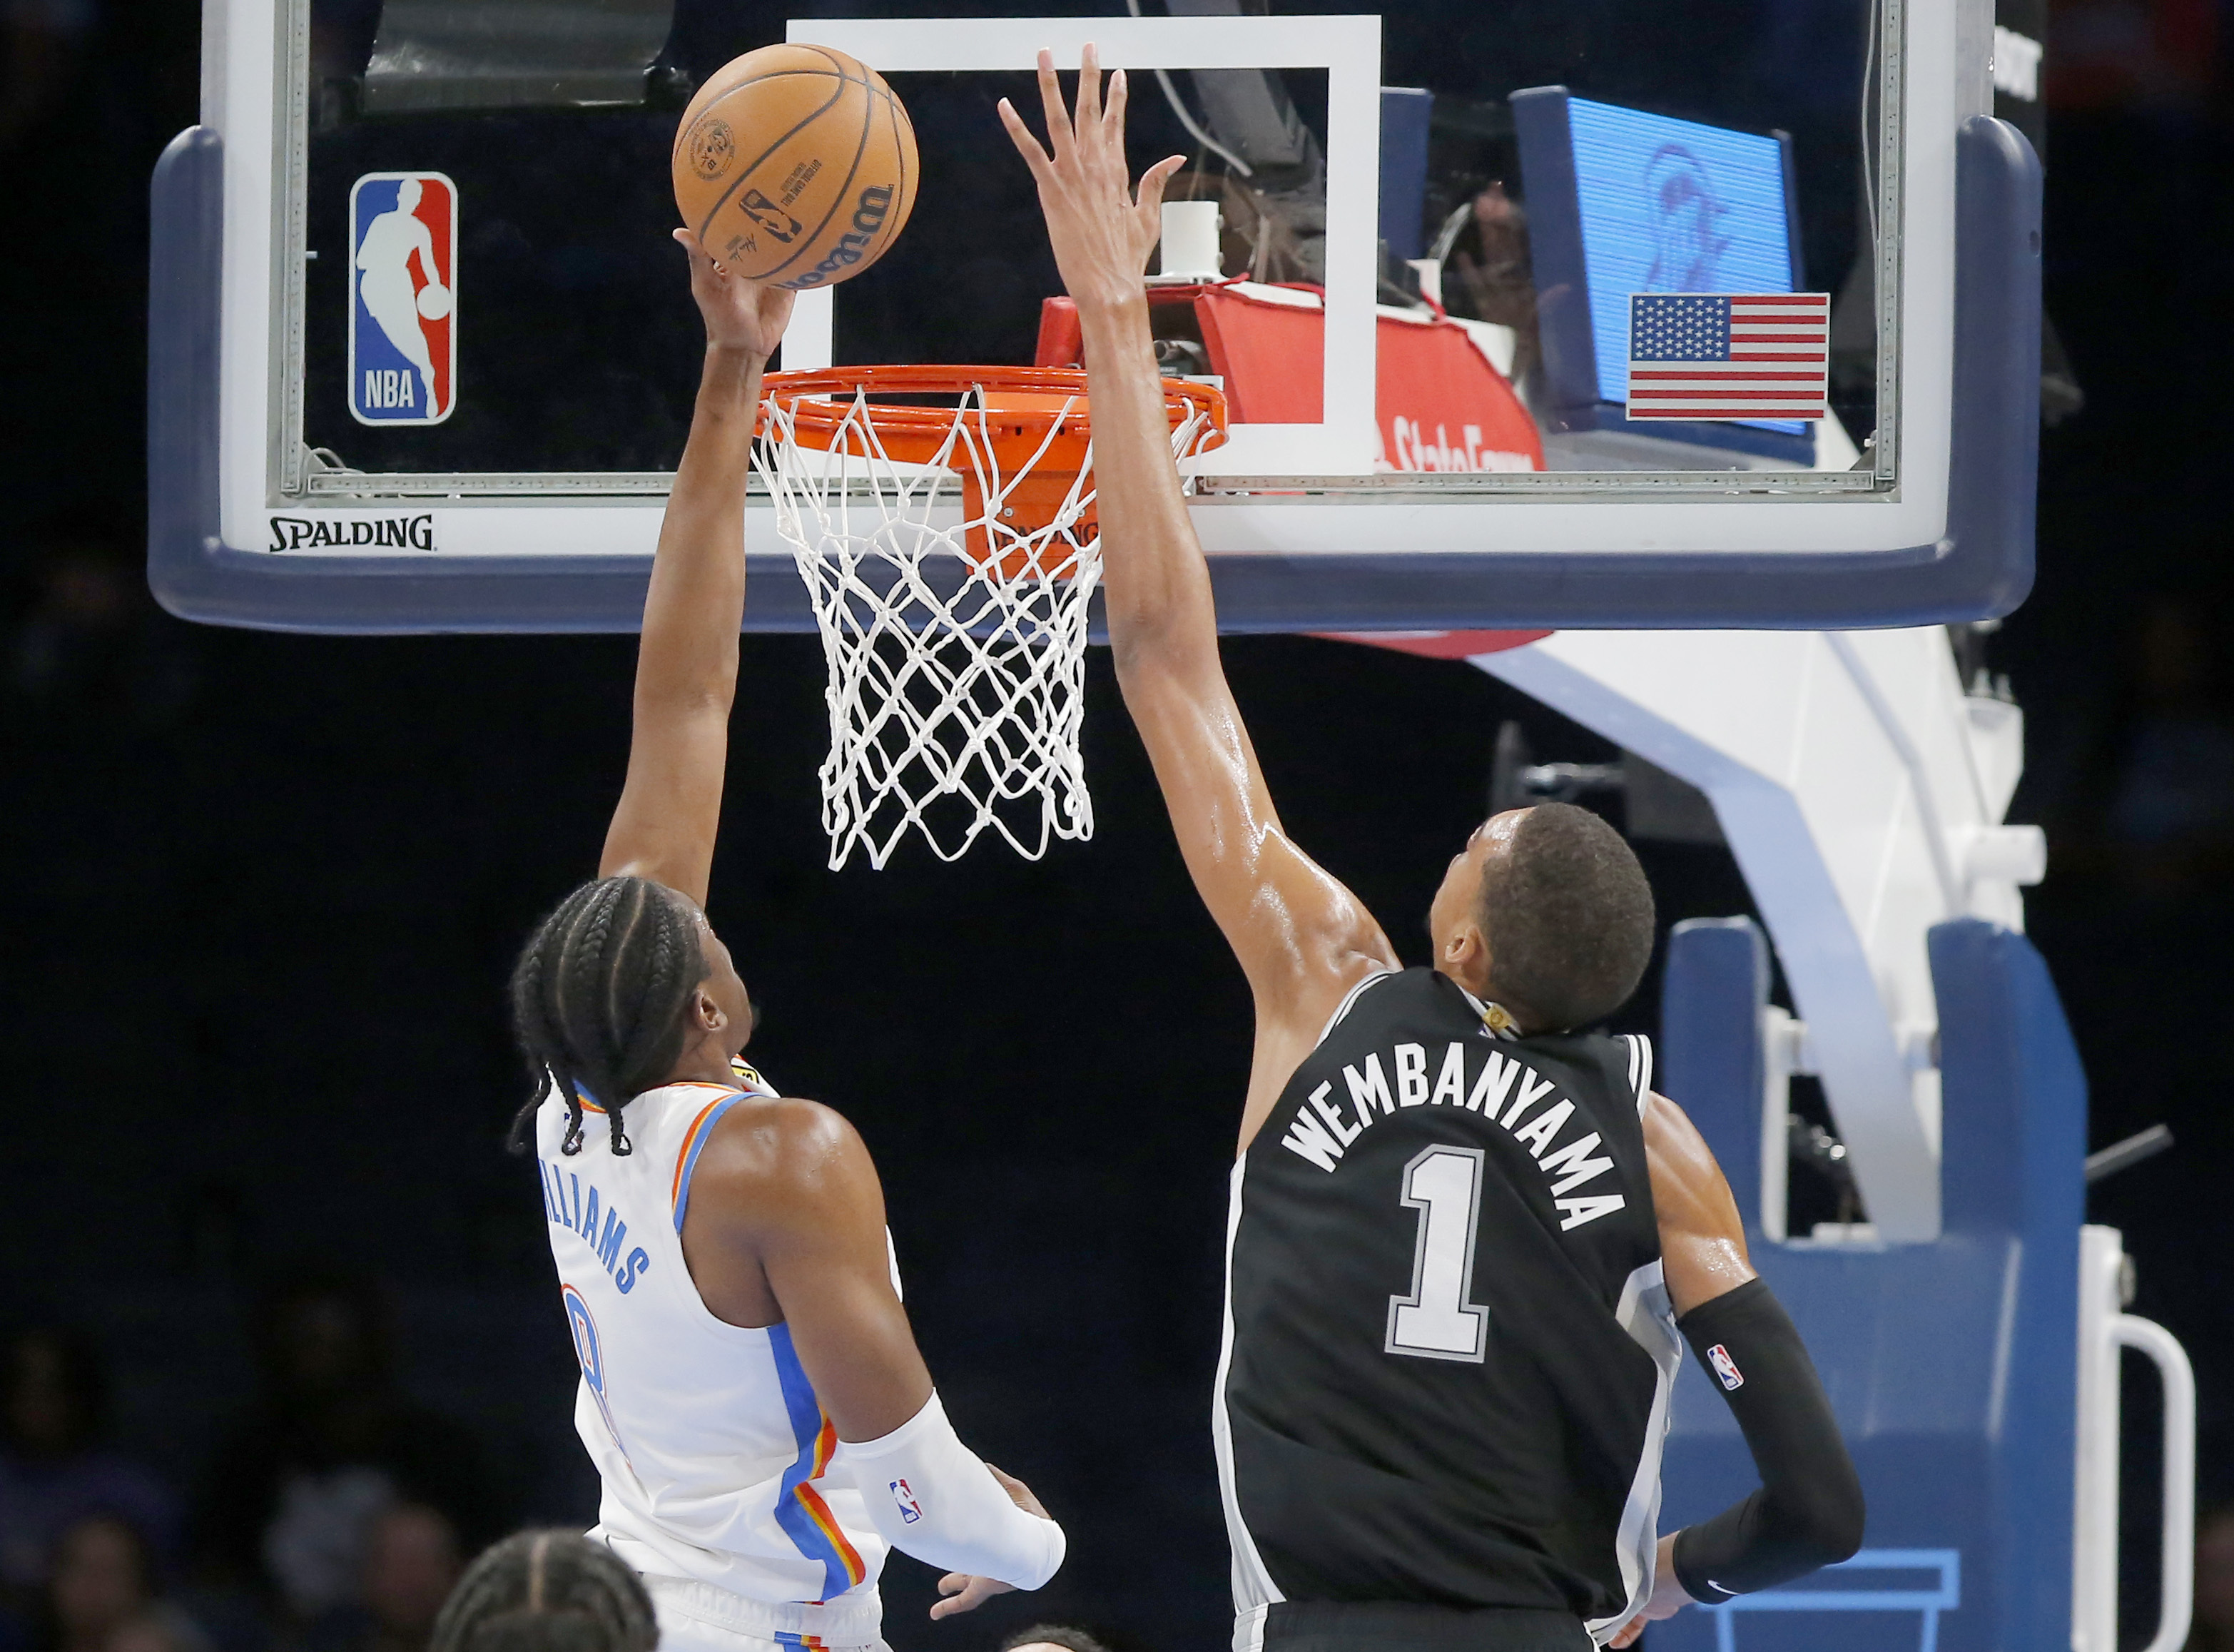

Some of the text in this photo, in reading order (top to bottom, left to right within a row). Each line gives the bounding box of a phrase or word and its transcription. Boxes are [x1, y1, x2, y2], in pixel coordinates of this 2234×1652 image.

[365, 369, 415, 408] NBA
[269, 514, 432, 552] SPALDING
[1281, 1041, 1625, 1232] WEMBANYAMA
[1384, 1143, 1490, 1364] 1
